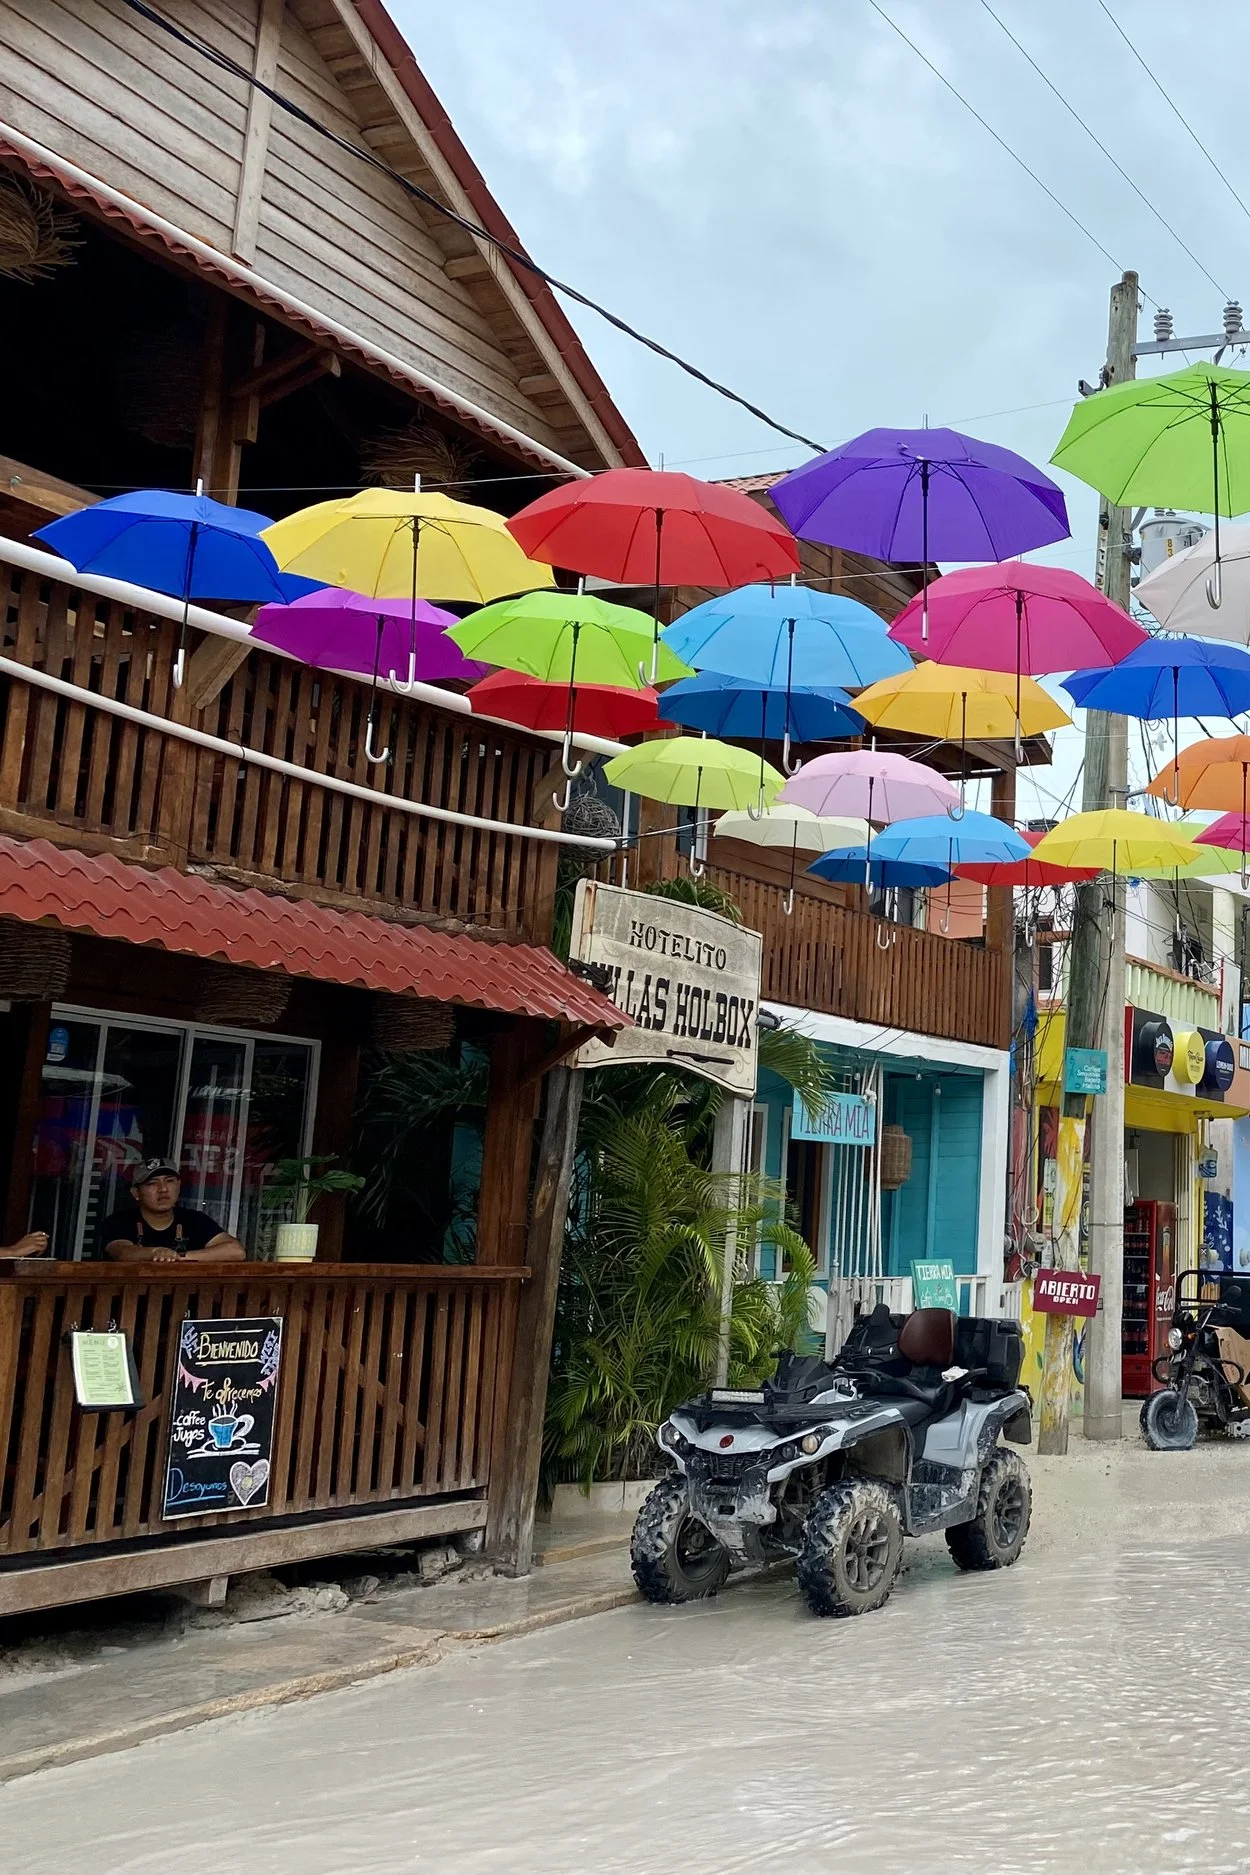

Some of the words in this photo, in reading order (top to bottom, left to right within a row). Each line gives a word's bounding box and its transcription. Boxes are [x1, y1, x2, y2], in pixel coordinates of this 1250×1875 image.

[629, 920, 727, 970] HOTELITO
[591, 961, 670, 1031] LLAS
[674, 983, 754, 1048] HOLBOX
[845, 1104, 869, 1139] MIA
[915, 1264, 941, 1281] TIERRA
[940, 1264, 954, 1280] MIA
[1039, 1279, 1096, 1300] ABIERTO
[1053, 1296, 1079, 1305] OPEN
[199, 1334, 259, 1359] BIENVENIDO
[215, 1377, 262, 1404] ofrecemos
